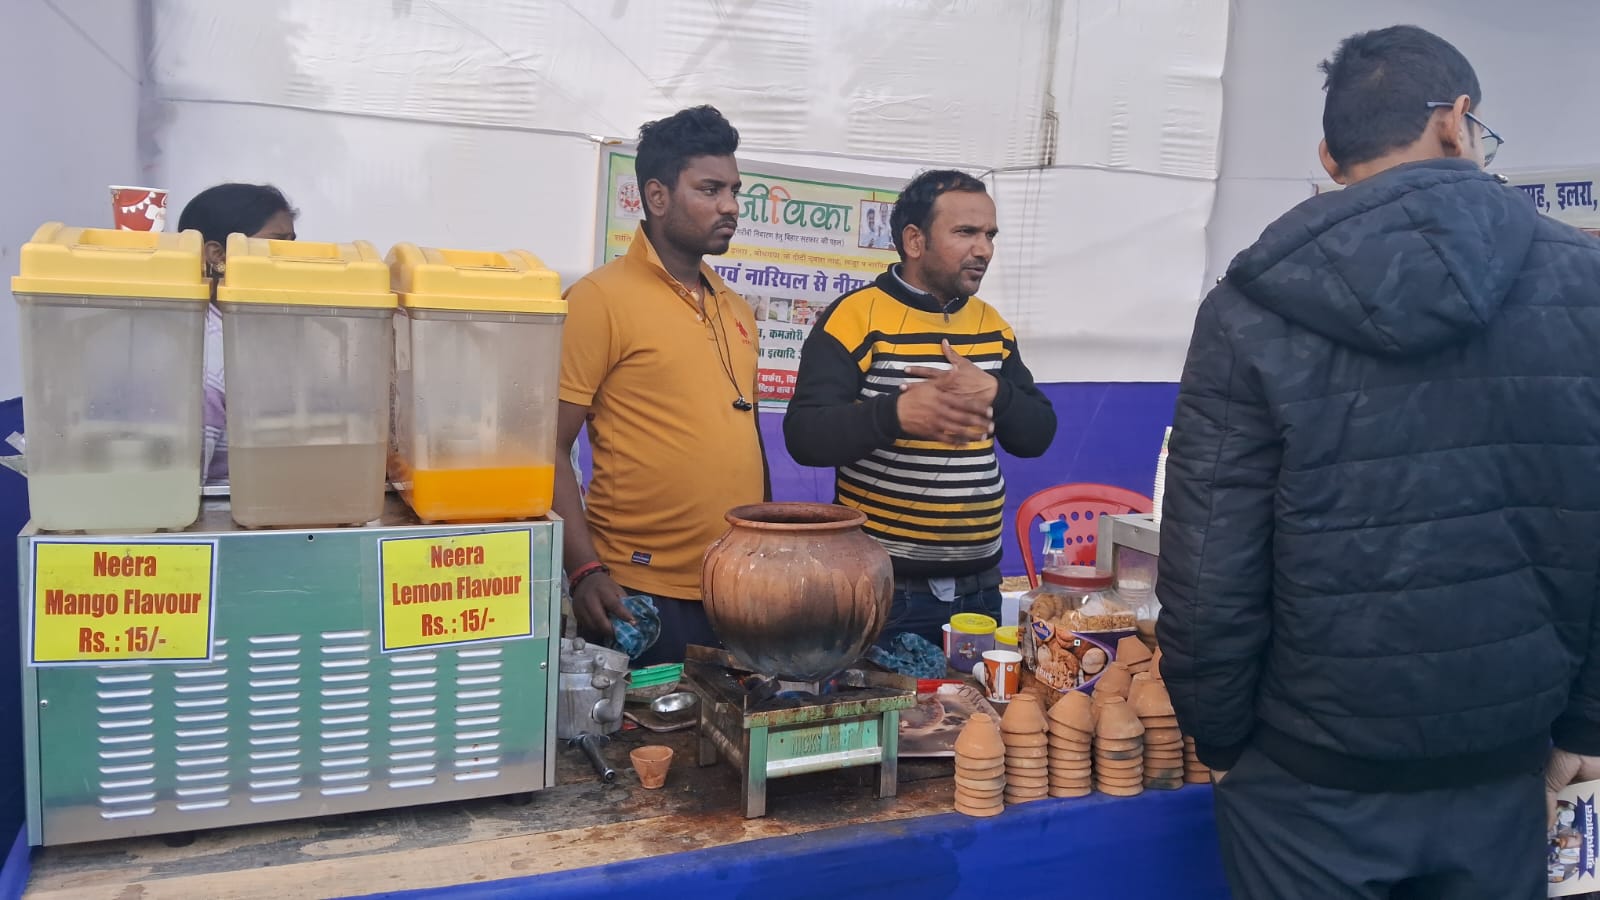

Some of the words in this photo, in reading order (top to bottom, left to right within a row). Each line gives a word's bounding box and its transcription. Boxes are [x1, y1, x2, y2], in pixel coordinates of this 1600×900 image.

[736, 183, 853, 233] जीविका
[1556, 181, 1598, 211] इलरा,
[745, 266, 809, 291] नारियल
[813, 270, 829, 292] से
[93, 551, 157, 577] Neera
[430, 545, 485, 568] Neera
[45, 589, 119, 618] Mango
[123, 589, 202, 615] Flavour
[392, 581, 453, 606] Lemon
[456, 575, 522, 600] Flavour
[459, 607, 495, 632] 15/-
[124, 626, 167, 652] 15/-
